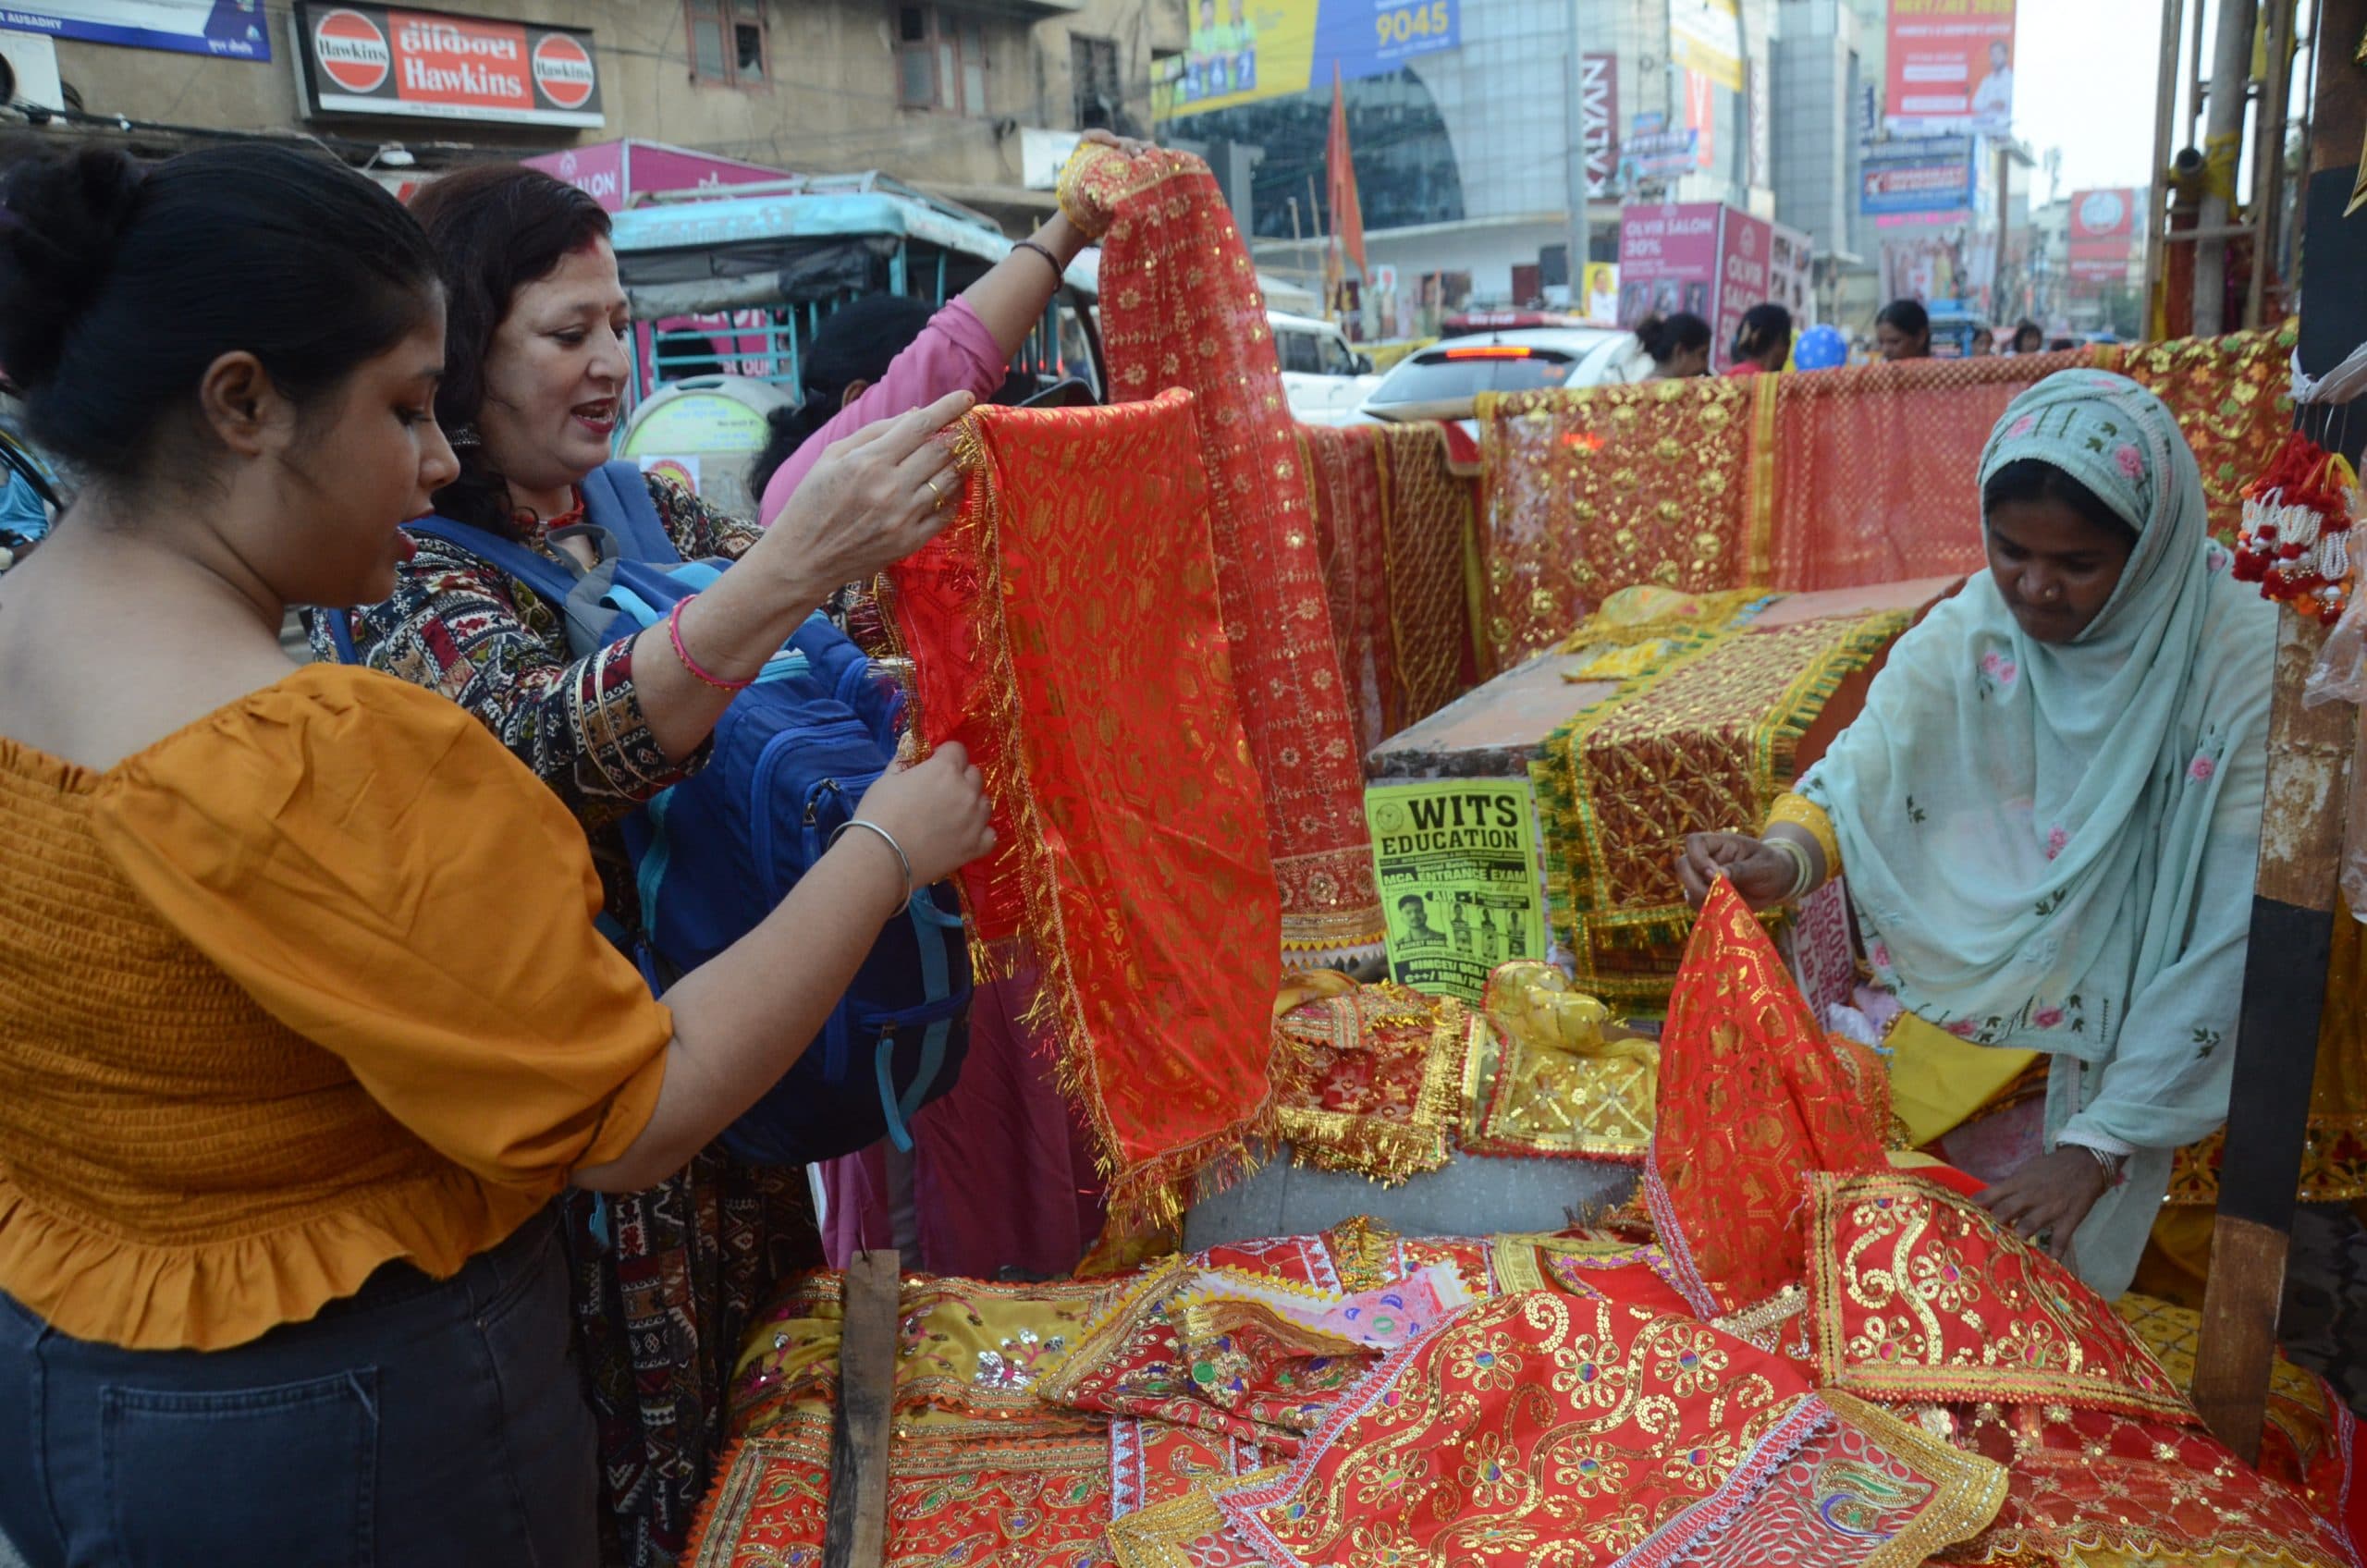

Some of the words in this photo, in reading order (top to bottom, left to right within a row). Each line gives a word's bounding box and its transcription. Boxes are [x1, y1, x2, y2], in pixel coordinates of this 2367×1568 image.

[1375, 1, 1449, 48] 9045
[318, 39, 386, 60] Hawkins
[404, 56, 522, 98] Hawkins
[536, 60, 592, 80] Hawkins
[1667, 216, 1712, 236] SALON
[1407, 794, 1518, 830] WITS
[1381, 830, 1518, 856] EDUCATION
[1383, 872, 1415, 886] MCA
[1417, 867, 1488, 881] ENTRANCE
[1490, 869, 1527, 883] EXAM
[1433, 890, 1456, 902] AIR
[1409, 959, 1457, 971] NIMCET/
[1404, 970, 1435, 984] C++/
